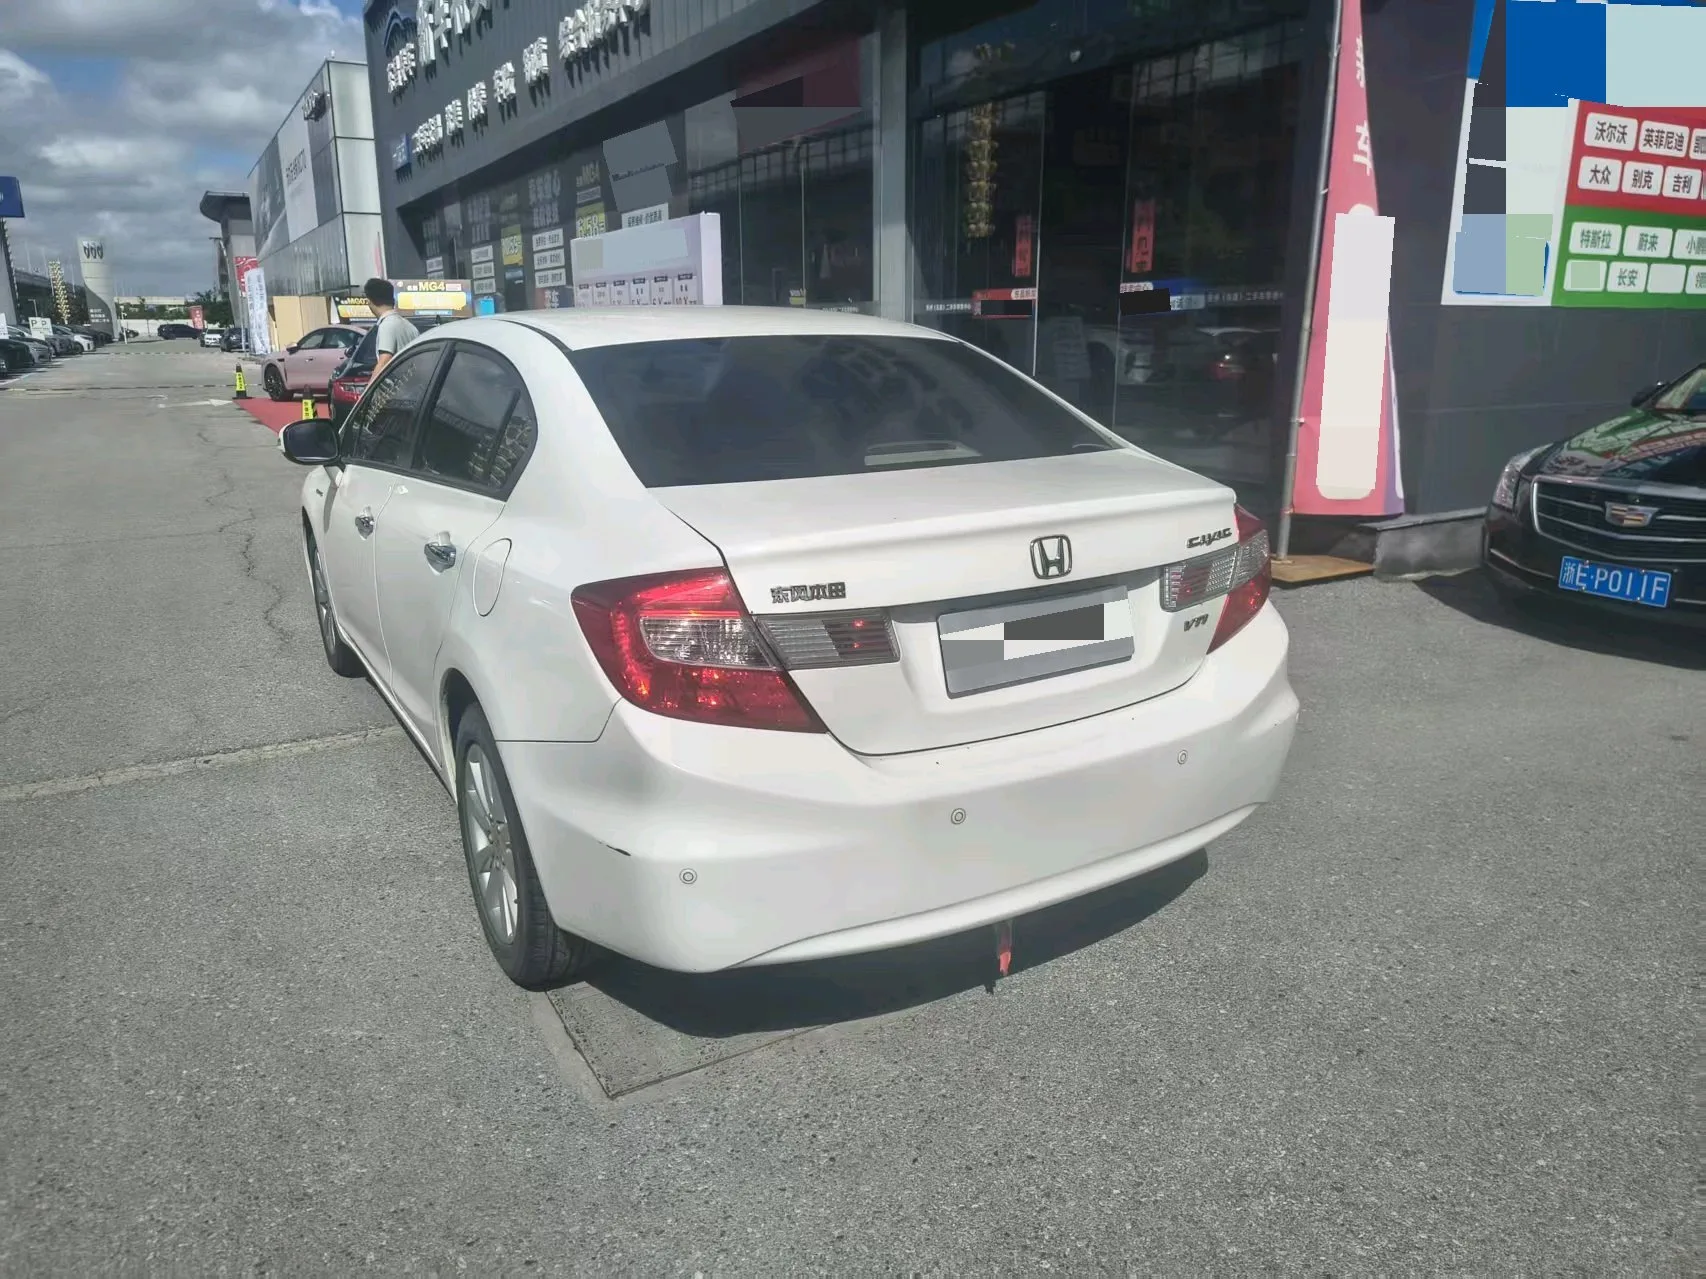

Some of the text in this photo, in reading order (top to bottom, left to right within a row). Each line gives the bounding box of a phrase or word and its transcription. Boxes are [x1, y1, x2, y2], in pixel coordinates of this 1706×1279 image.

[1595, 121, 1628, 144] 沃尔沃
[1643, 128, 1685, 152] 英菲尼迪
[1589, 164, 1611, 185] 大众
[1632, 169, 1654, 190] 别克
[1672, 174, 1693, 194] 吉利
[1580, 228, 1612, 249] 特斯拉
[1637, 232, 1659, 252] 蔚来
[418, 281, 445, 291] MG4
[1617, 267, 1638, 287] 长安
[1186, 528, 1232, 548] CIVIC
[770, 582, 846, 604] 东风本田
